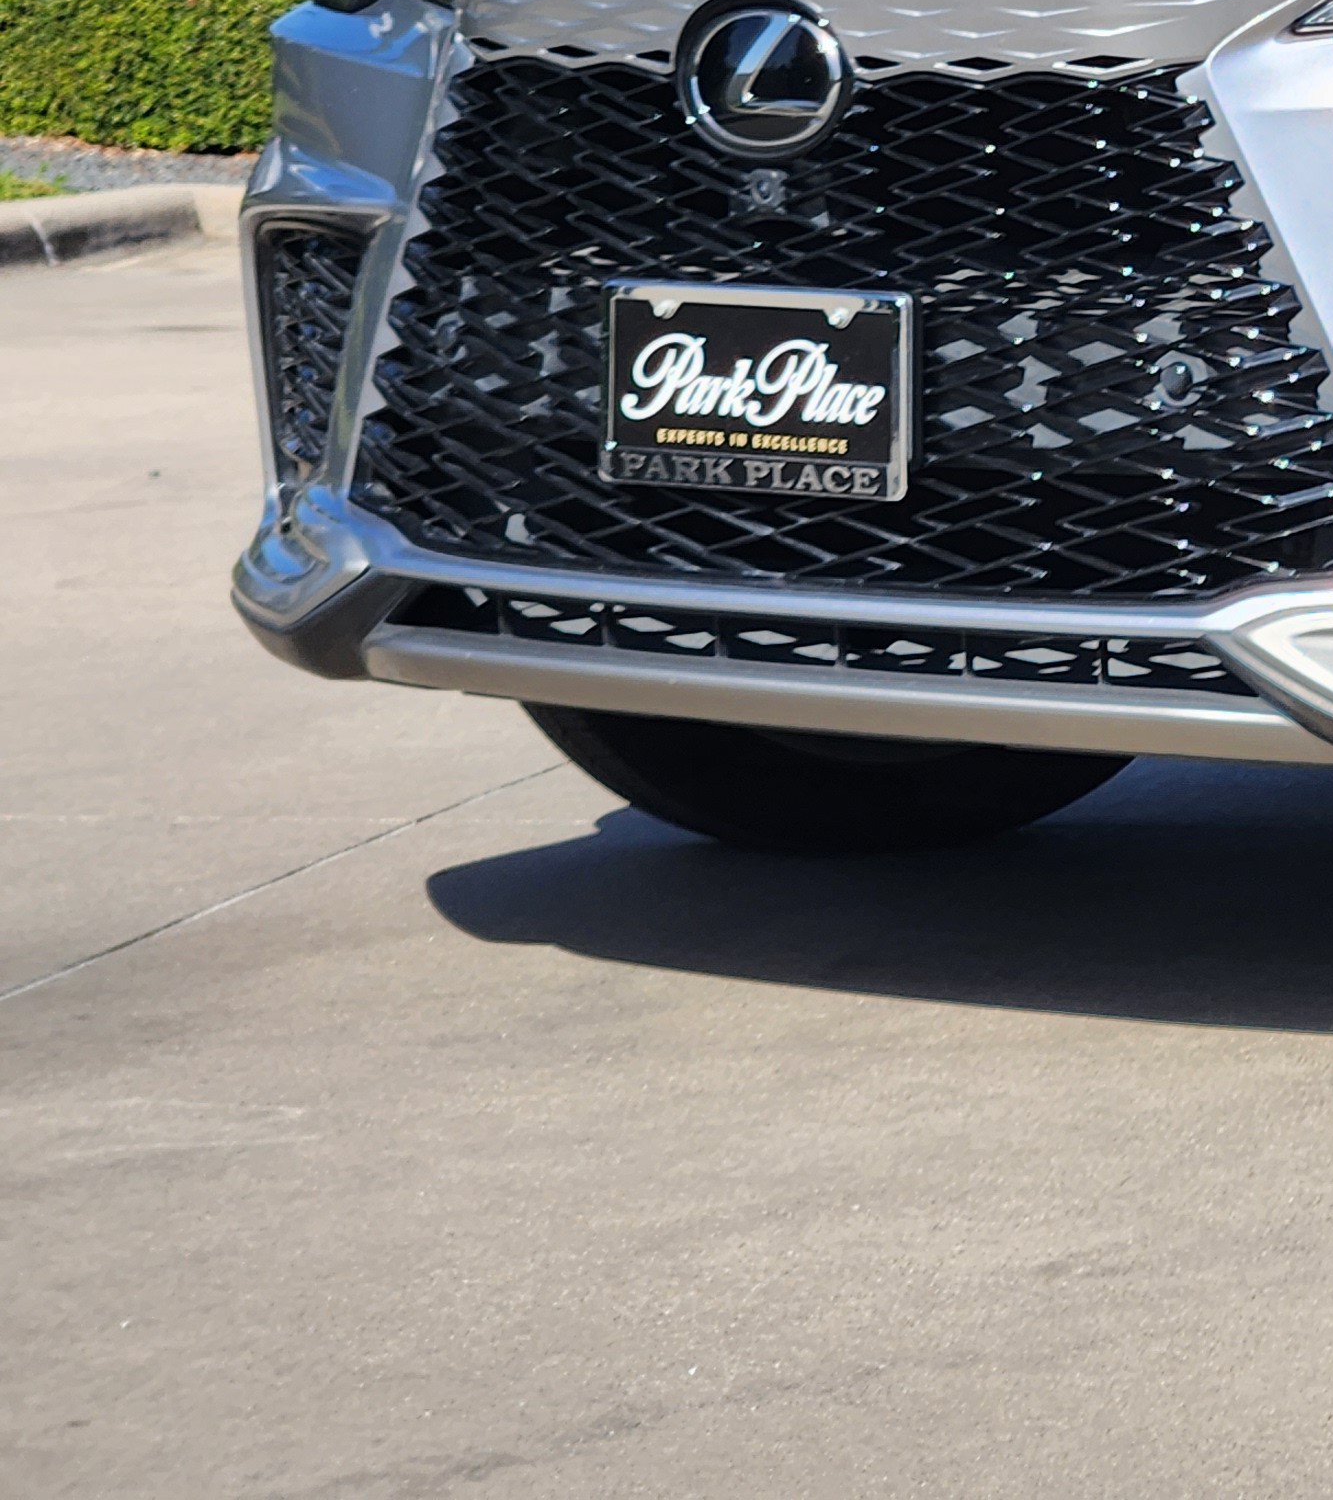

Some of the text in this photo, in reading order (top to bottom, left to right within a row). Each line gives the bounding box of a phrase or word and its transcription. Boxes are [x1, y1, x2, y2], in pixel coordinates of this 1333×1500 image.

[620, 332, 886, 427] Park Place
[751, 433, 848, 455] EXCELLENCE
[620, 451, 881, 495] PARK PLACE
